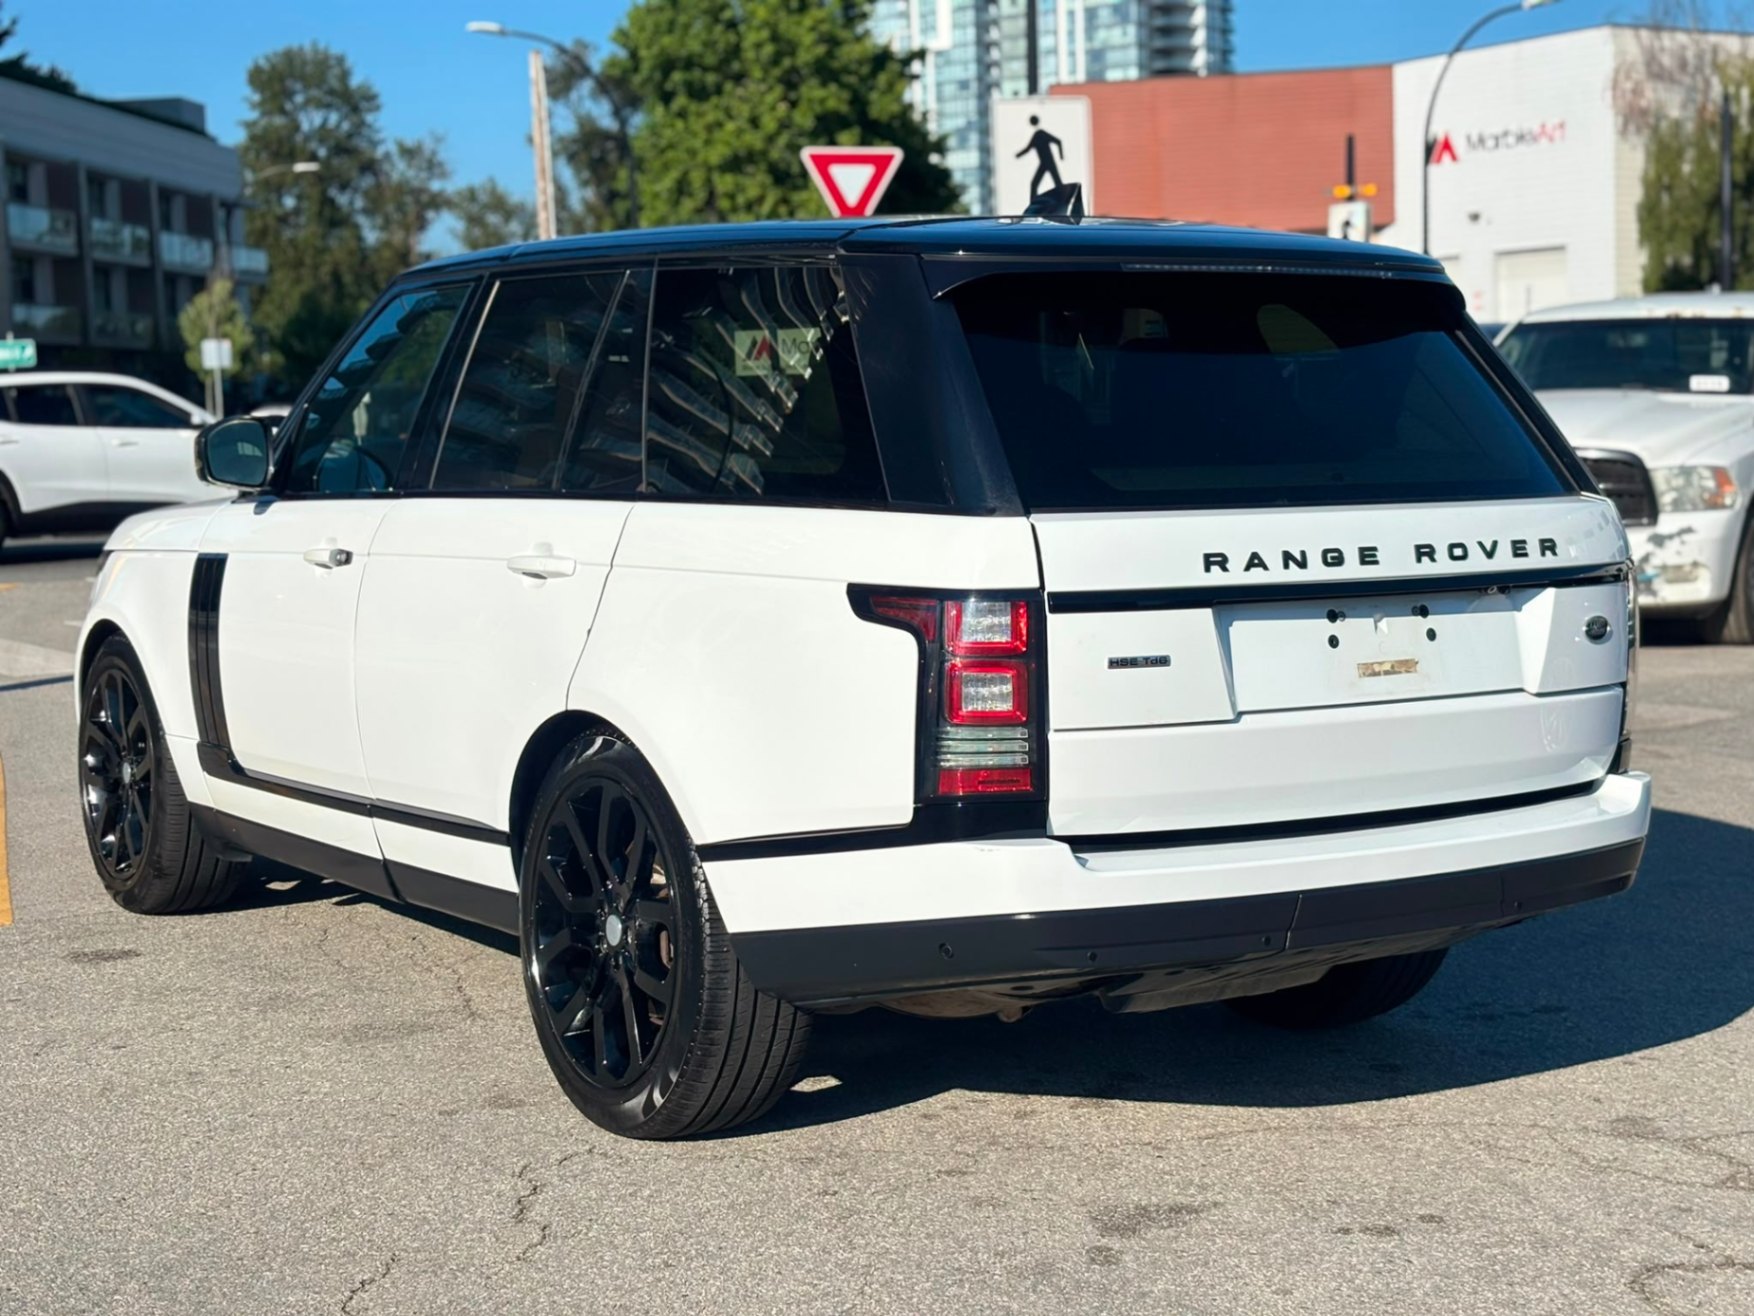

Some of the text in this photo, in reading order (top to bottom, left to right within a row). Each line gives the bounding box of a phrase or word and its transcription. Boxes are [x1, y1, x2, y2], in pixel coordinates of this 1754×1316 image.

[1203, 537, 1558, 573] RANGE ROVER
[1110, 656, 1168, 667] HSE Td6
